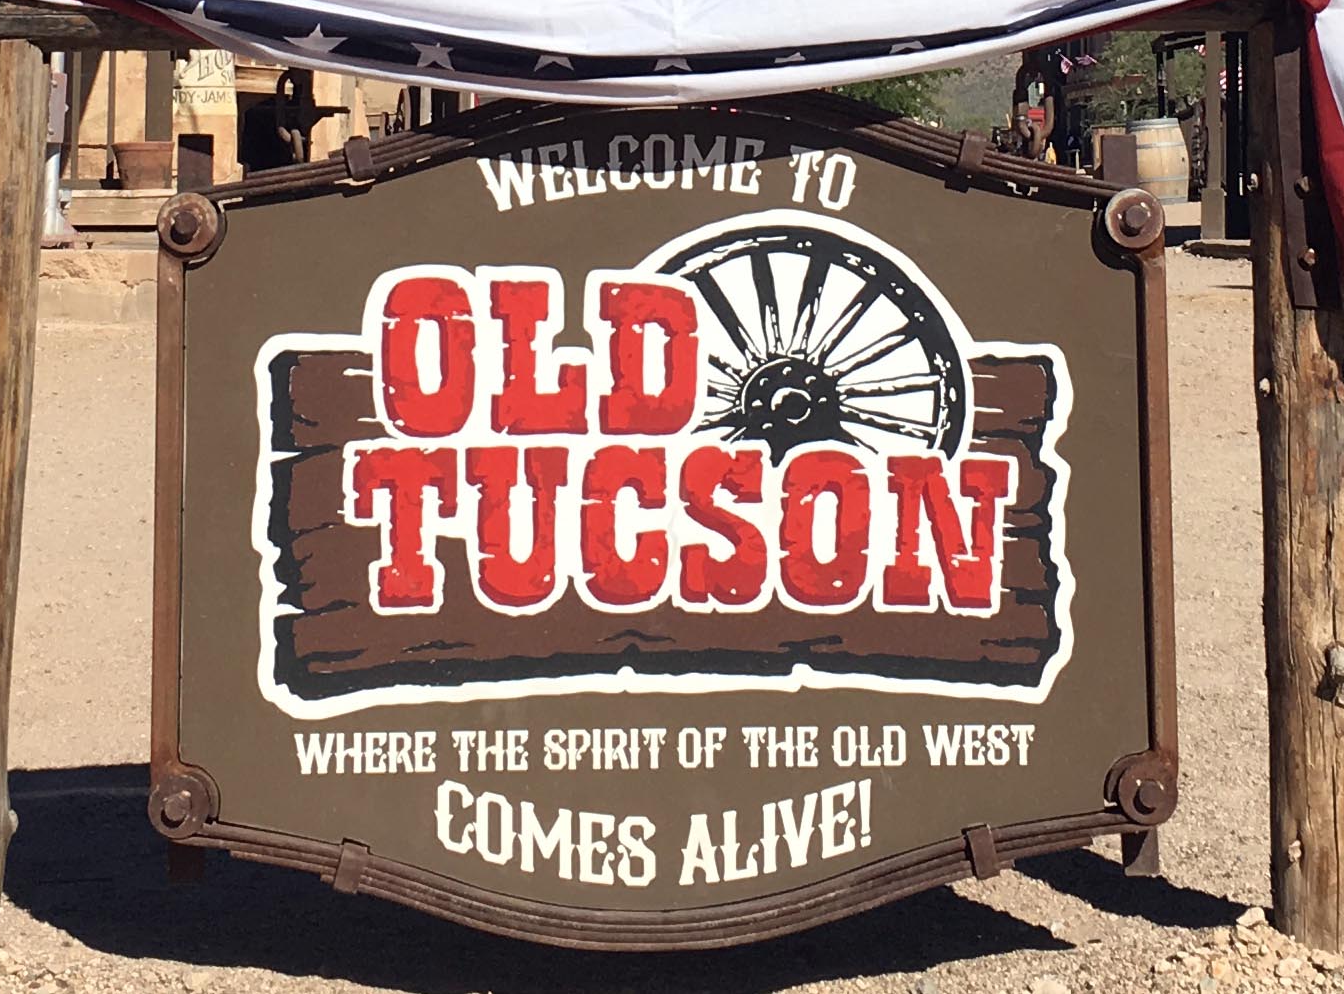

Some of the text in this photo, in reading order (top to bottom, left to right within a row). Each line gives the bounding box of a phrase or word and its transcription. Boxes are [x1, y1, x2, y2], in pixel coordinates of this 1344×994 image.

[476, 134, 857, 212] WELCOME TO
[381, 277, 700, 436] OLD
[353, 446, 1008, 608] TUCSON
[294, 723, 1036, 775] WHERE THE SPIRIT OF THE OLD WEST
[434, 778, 873, 887] COMES ALIVE!
